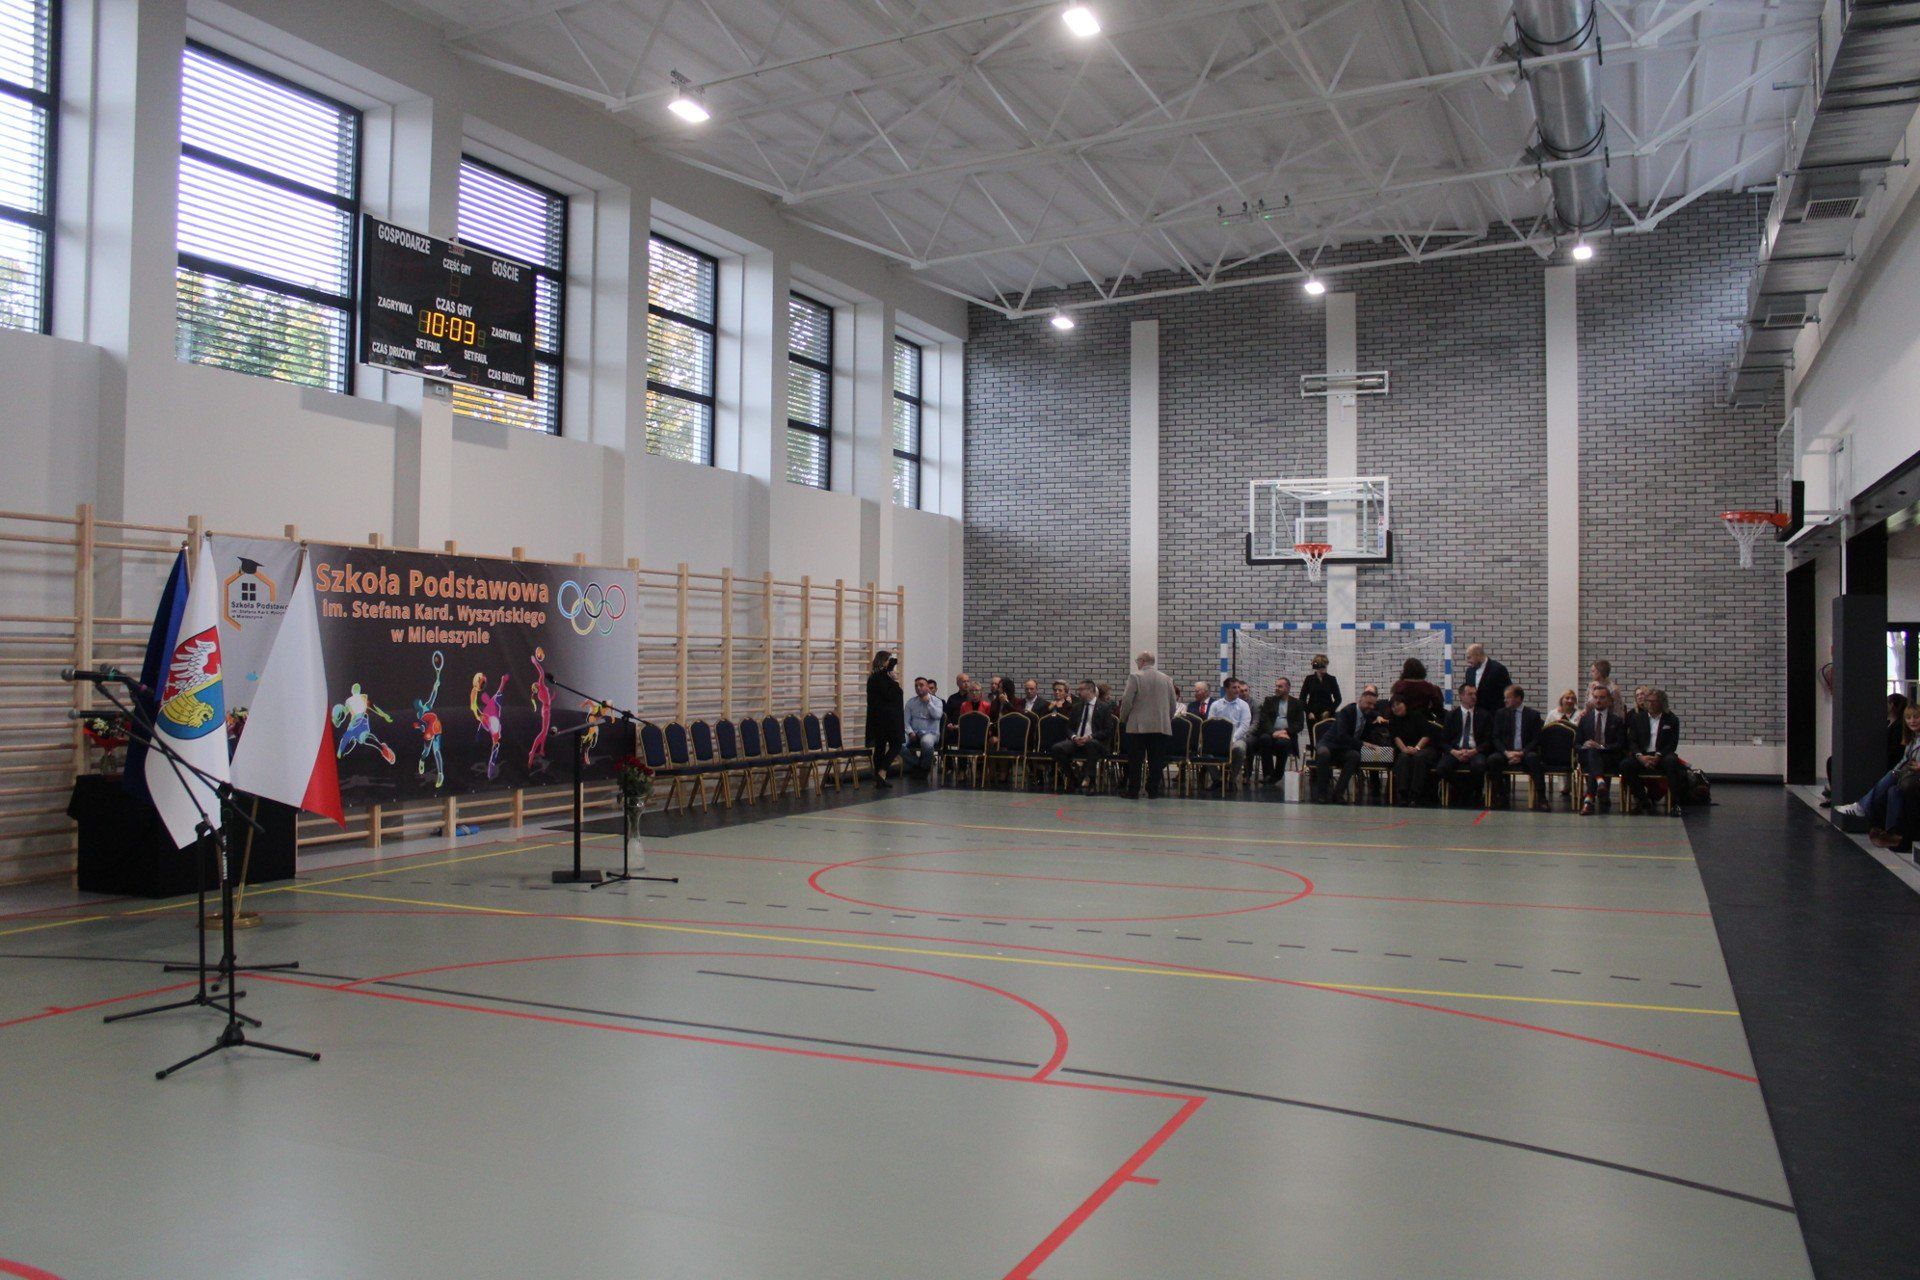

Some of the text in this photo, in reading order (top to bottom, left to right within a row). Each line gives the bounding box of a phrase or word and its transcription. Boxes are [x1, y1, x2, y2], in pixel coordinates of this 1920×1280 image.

[378, 224, 431, 255] GOSPODARZE
[442, 258, 472, 275] CZĘŚĆ GRY
[491, 260, 520, 282] GOŚCIE
[377, 295, 413, 315] ZAGRYWKA
[435, 297, 473, 317] CZAS GRY
[426, 311, 475, 345] 10:03
[491, 327, 523, 343] ZAGRYWKA
[372, 342, 417, 361] CZAS DRUŻYNY
[487, 368, 526, 386] CZAS DRUŻYNY
[316, 563, 550, 603] Szkoła Podstawowa
[322, 599, 547, 628] im. Stefana Kard. Wyszyńskiego
[391, 626, 491, 648] w Mieleszynie
